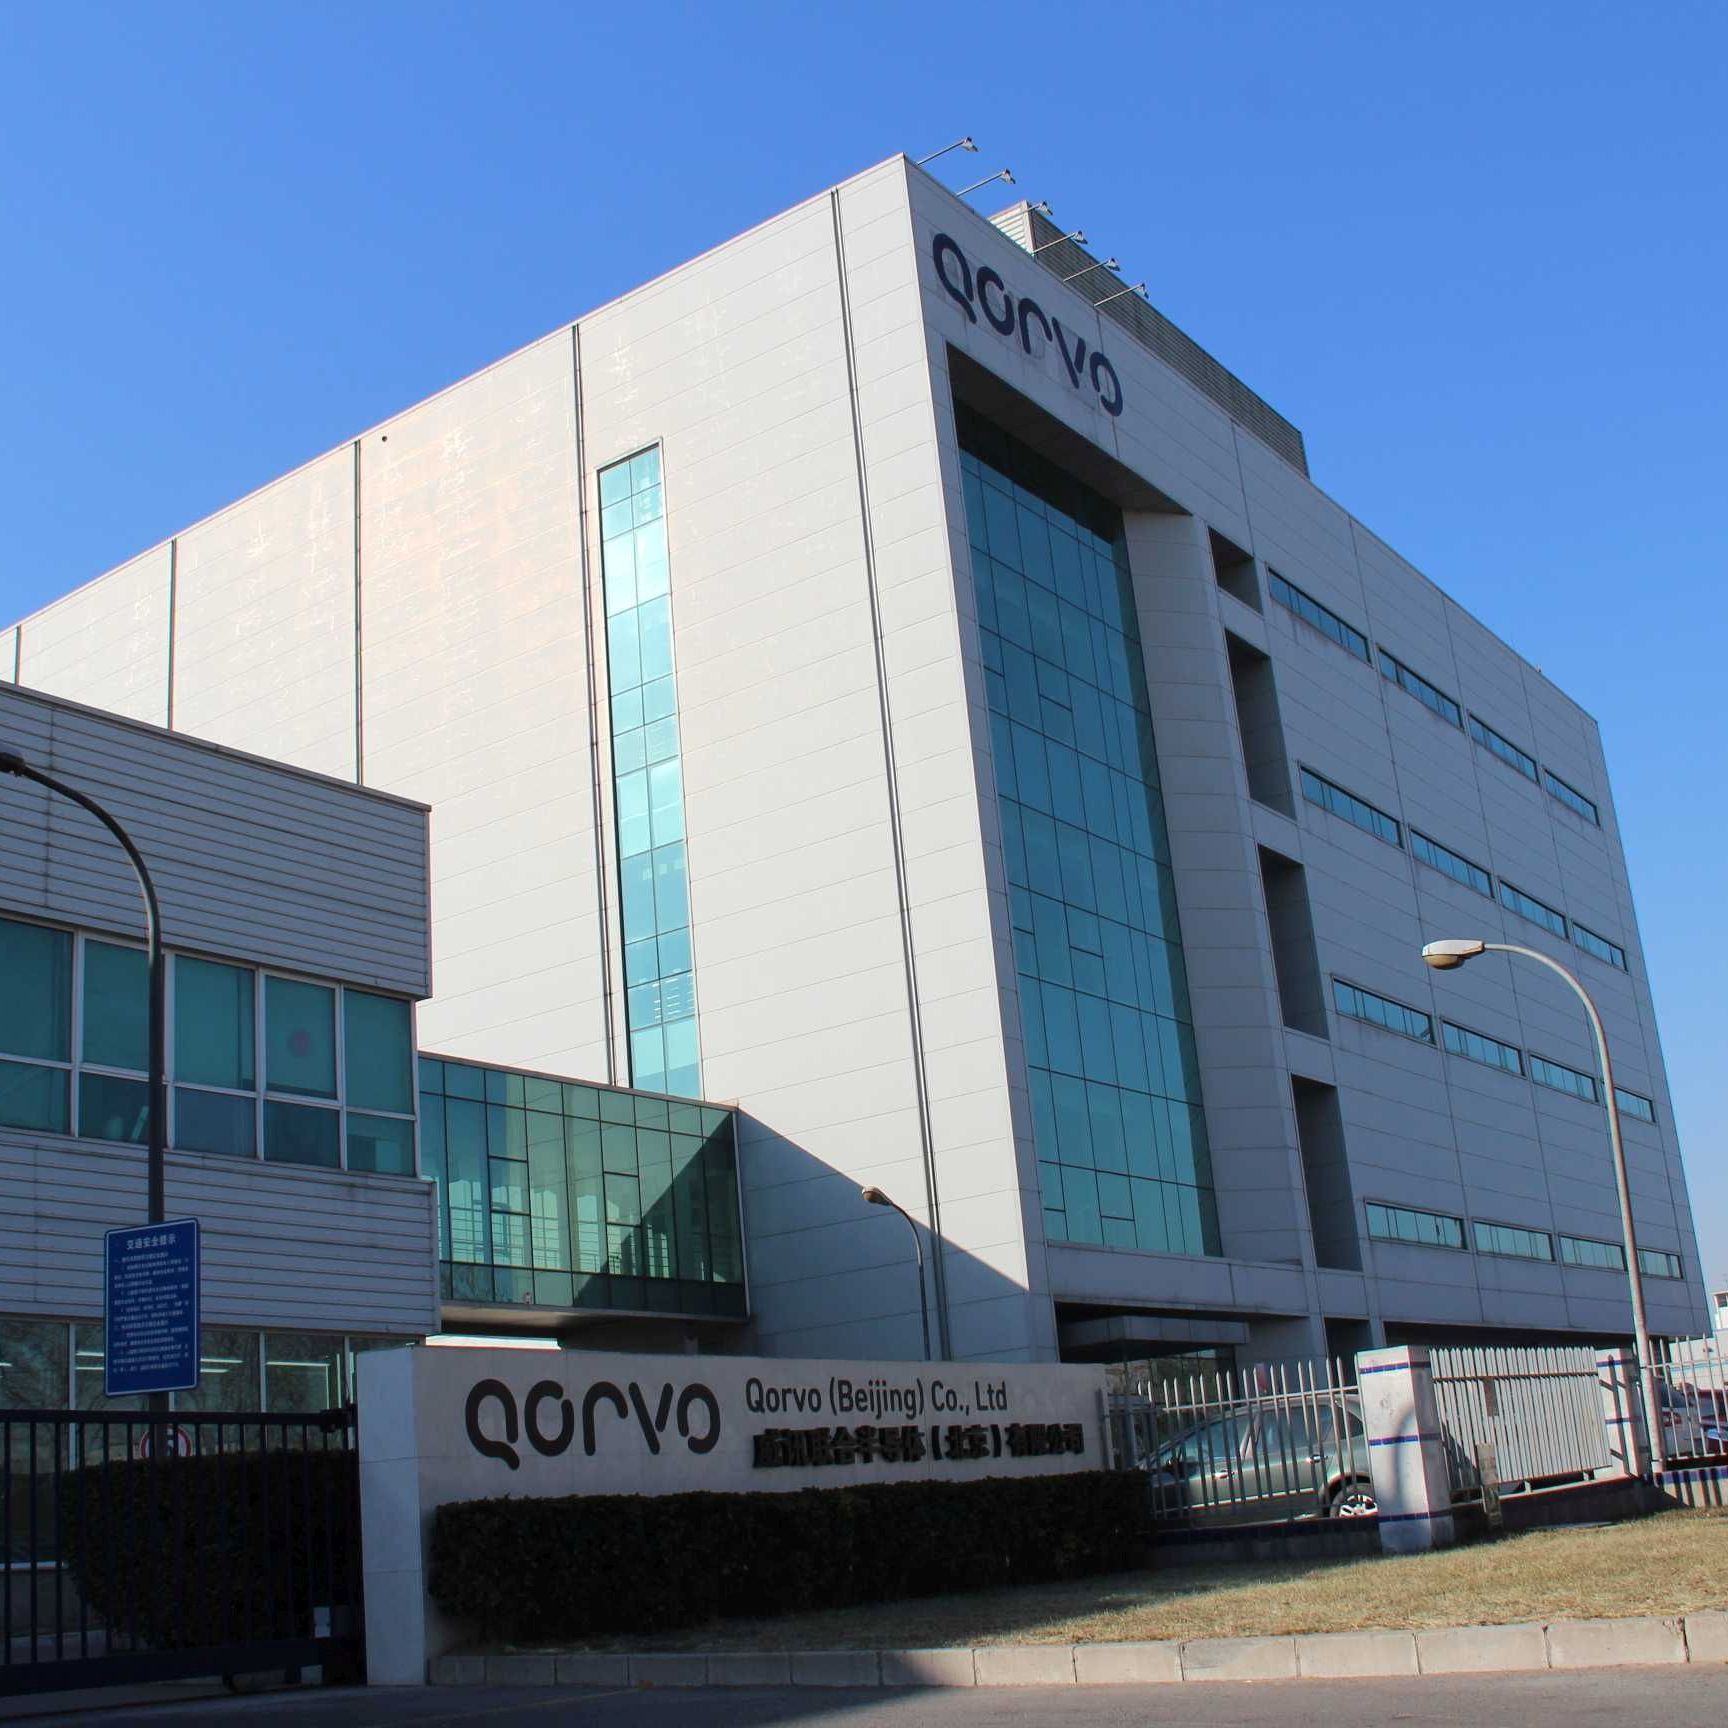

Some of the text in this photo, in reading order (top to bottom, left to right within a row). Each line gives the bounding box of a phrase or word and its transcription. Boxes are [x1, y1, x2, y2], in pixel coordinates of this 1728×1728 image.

[745, 1377, 822, 1416] Qorvo
[829, 1376, 926, 1421] (Beijing)
[975, 1380, 1009, 1412] Ltd
